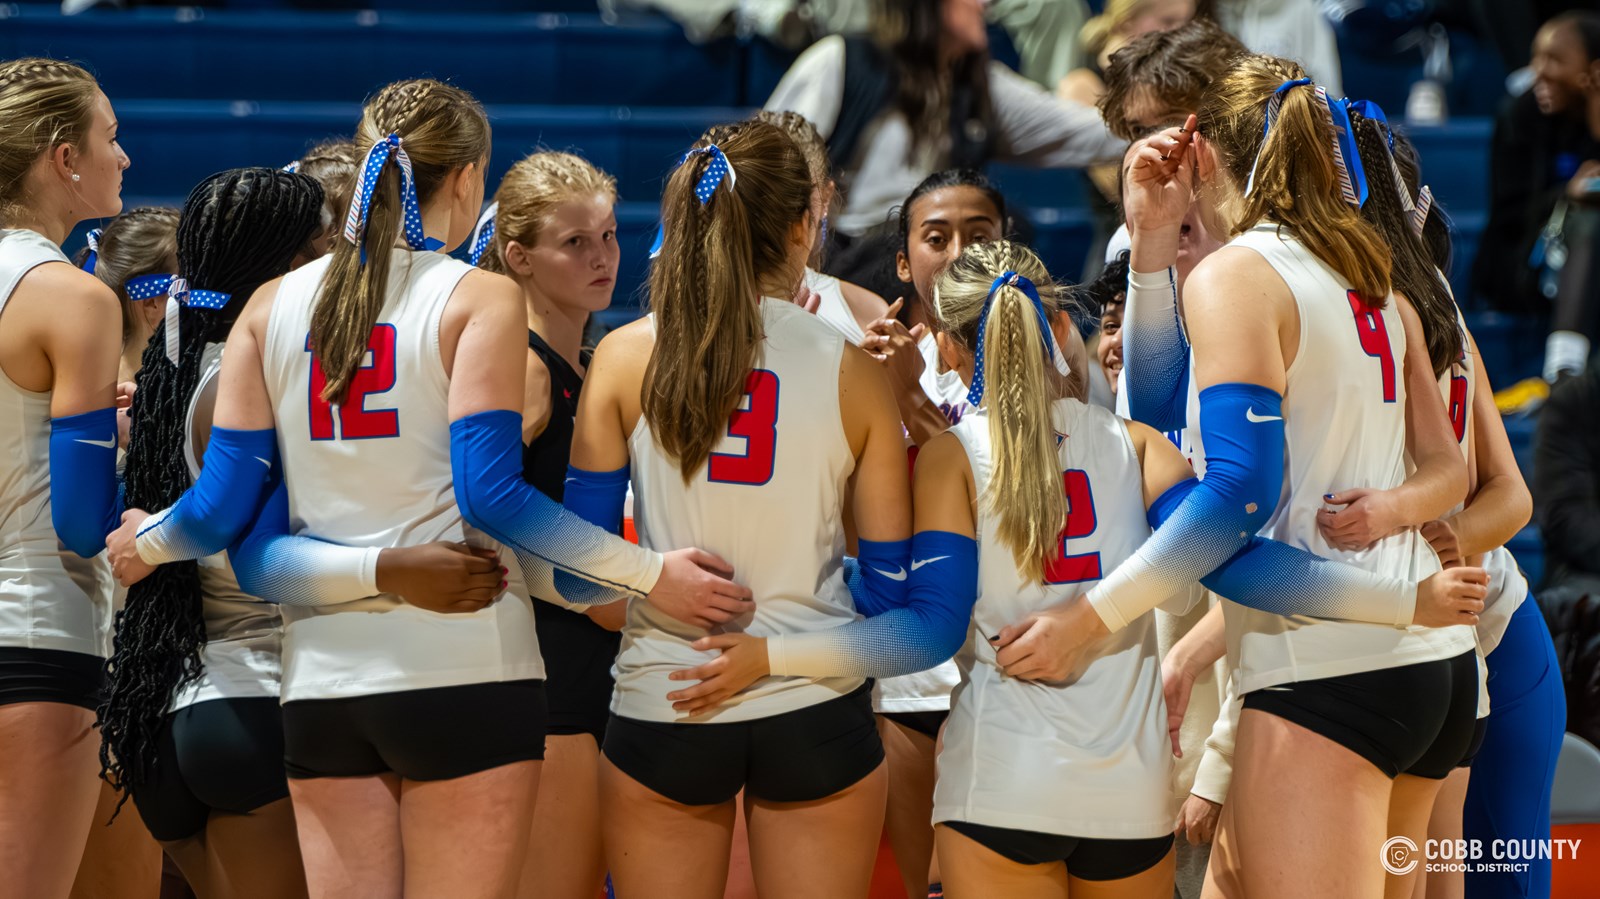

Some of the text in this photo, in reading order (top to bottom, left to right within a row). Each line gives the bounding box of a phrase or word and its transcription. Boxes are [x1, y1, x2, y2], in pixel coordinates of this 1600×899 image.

[304, 322, 401, 441] 12
[707, 367, 781, 487] 3
[1041, 469, 1103, 586] 2
